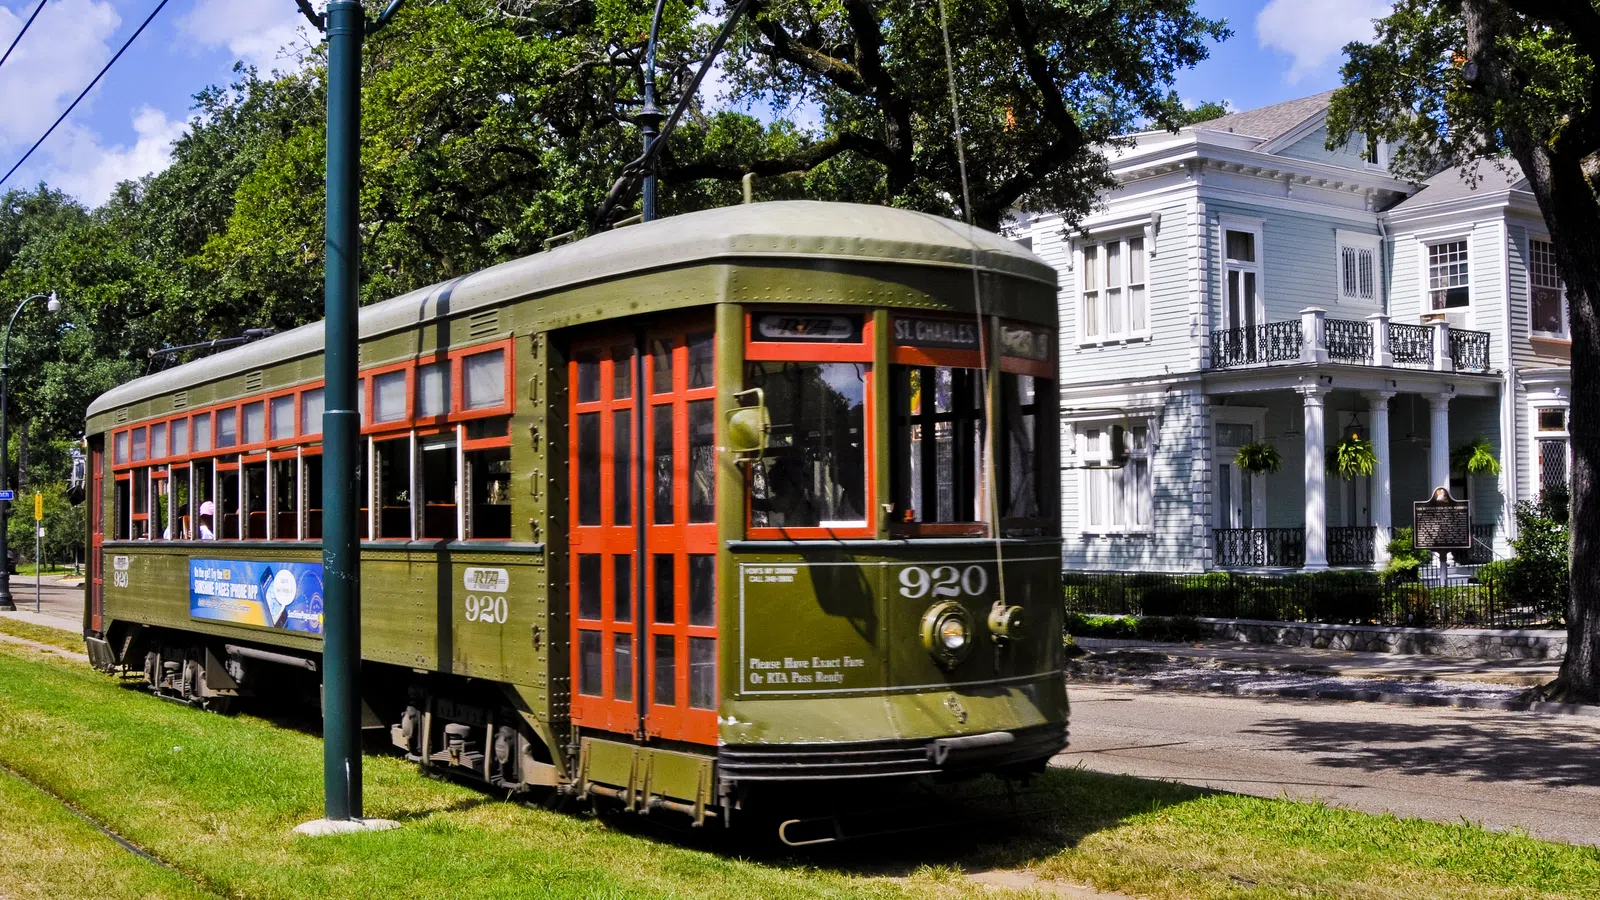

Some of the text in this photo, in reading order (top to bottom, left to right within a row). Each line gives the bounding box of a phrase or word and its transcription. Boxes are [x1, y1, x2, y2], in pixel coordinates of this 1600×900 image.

[916, 320, 975, 344] CHARLES
[114, 571, 128, 588] 920
[474, 570, 499, 585] RTA
[898, 564, 988, 599] 920
[194, 579, 215, 596] SUNSHINE
[215, 581, 230, 597] PAGES
[248, 584, 258, 600] APP
[465, 594, 508, 624] 920
[749, 656, 865, 669] Please Have Exact Fare
[749, 671, 845, 684] Or RTA Pass Ready
